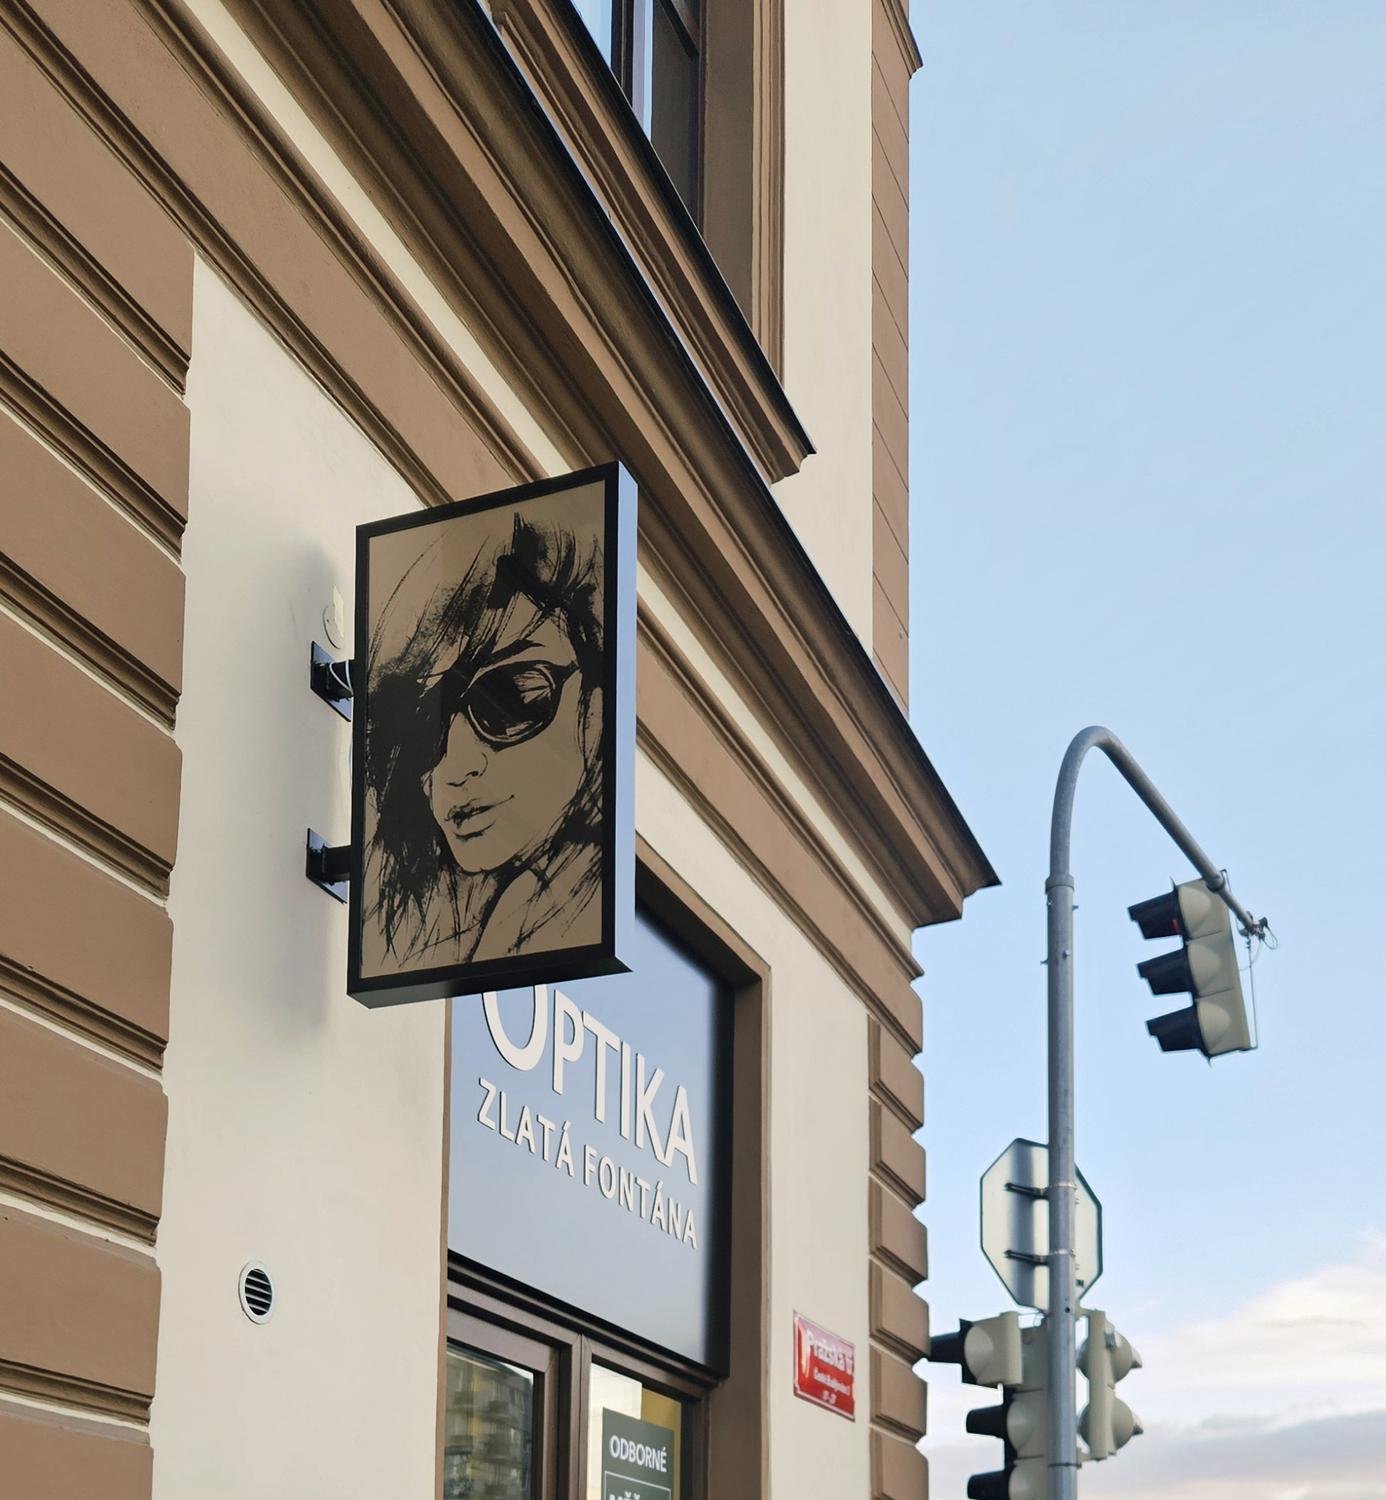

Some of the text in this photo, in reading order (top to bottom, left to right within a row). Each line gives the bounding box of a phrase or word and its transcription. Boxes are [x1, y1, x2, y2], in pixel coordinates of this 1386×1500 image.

[477, 1077, 697, 1250] ZLATÁ FONTÁNA
[482, 983, 698, 1186] OPTIKA
[608, 1434, 667, 1473] ODBORNÉ
